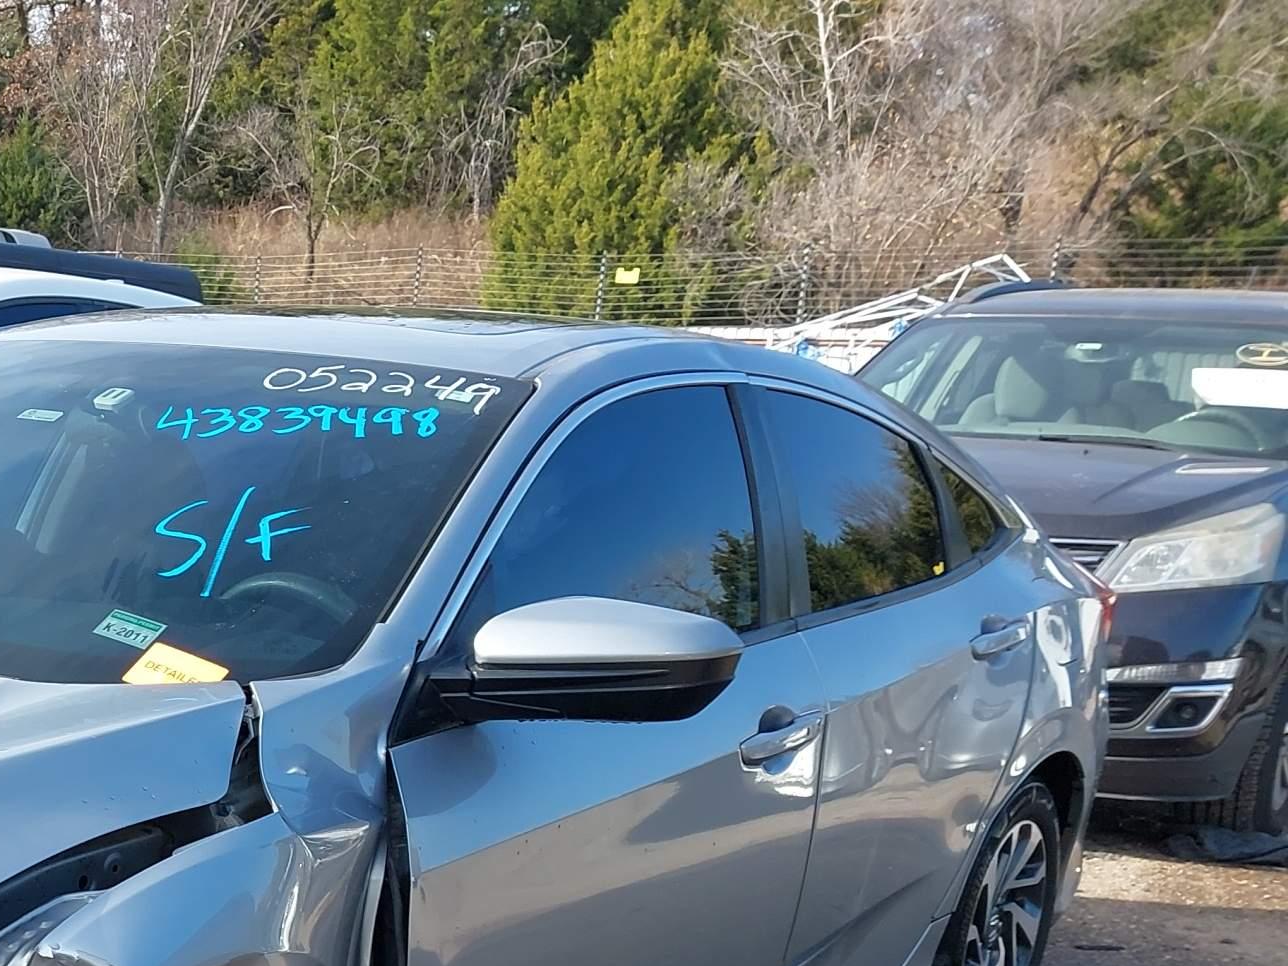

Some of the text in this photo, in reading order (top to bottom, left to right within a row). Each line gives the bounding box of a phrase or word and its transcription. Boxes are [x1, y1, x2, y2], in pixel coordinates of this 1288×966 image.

[263, 365, 502, 415] 052249
[156, 404, 440, 440] 43839498
[155, 486, 313, 597] S/F
[102, 622, 150, 644] K-2011
[144, 660, 201, 684] DETAILE
